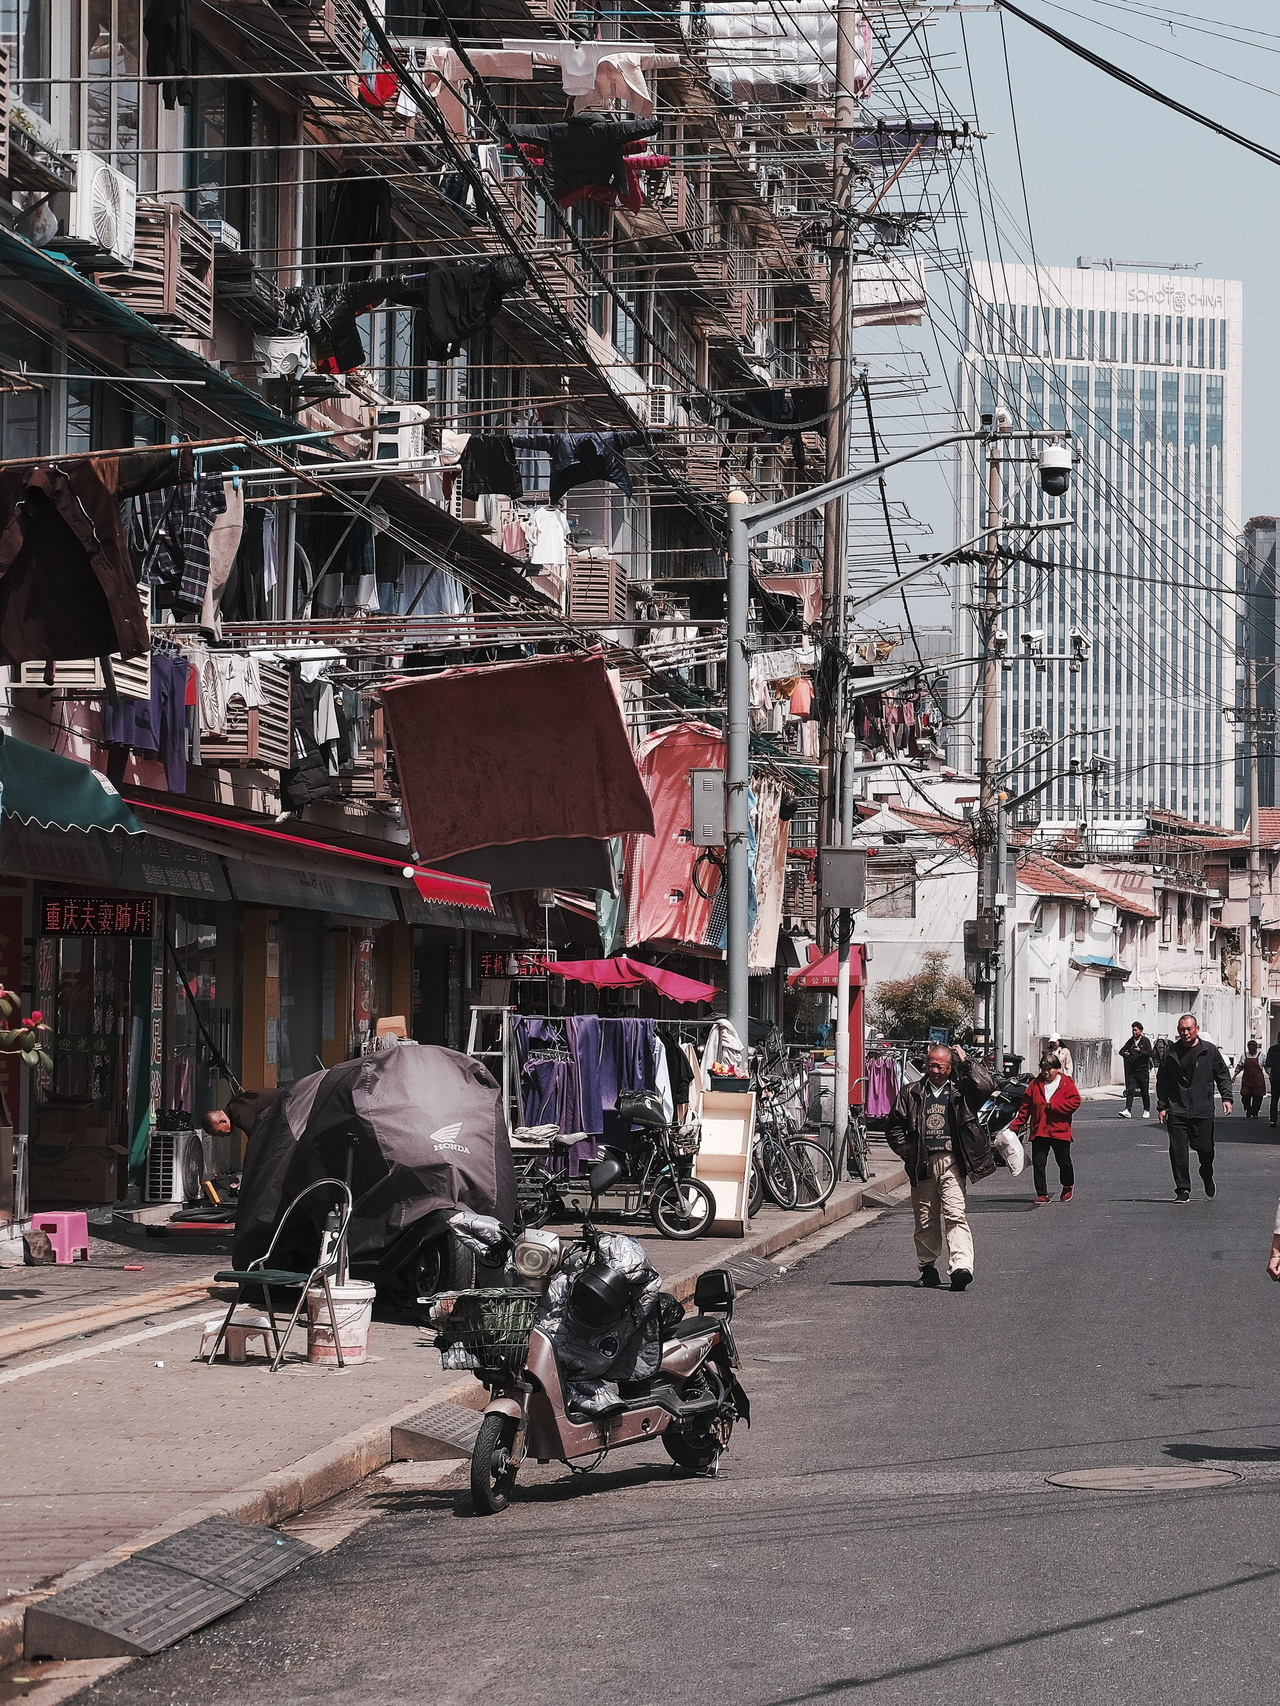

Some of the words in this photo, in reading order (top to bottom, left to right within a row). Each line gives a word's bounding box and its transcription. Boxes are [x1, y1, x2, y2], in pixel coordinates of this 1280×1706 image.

[1127, 288, 1165, 305] SOHO
[1187, 293, 1223, 308] CHINA
[45, 902, 148, 933] 重庆夫妻肺片
[811, 976, 838, 985] 公用电
[58, 1037, 107, 1053] 迎光临
[433, 1142, 471, 1155] HONDA
